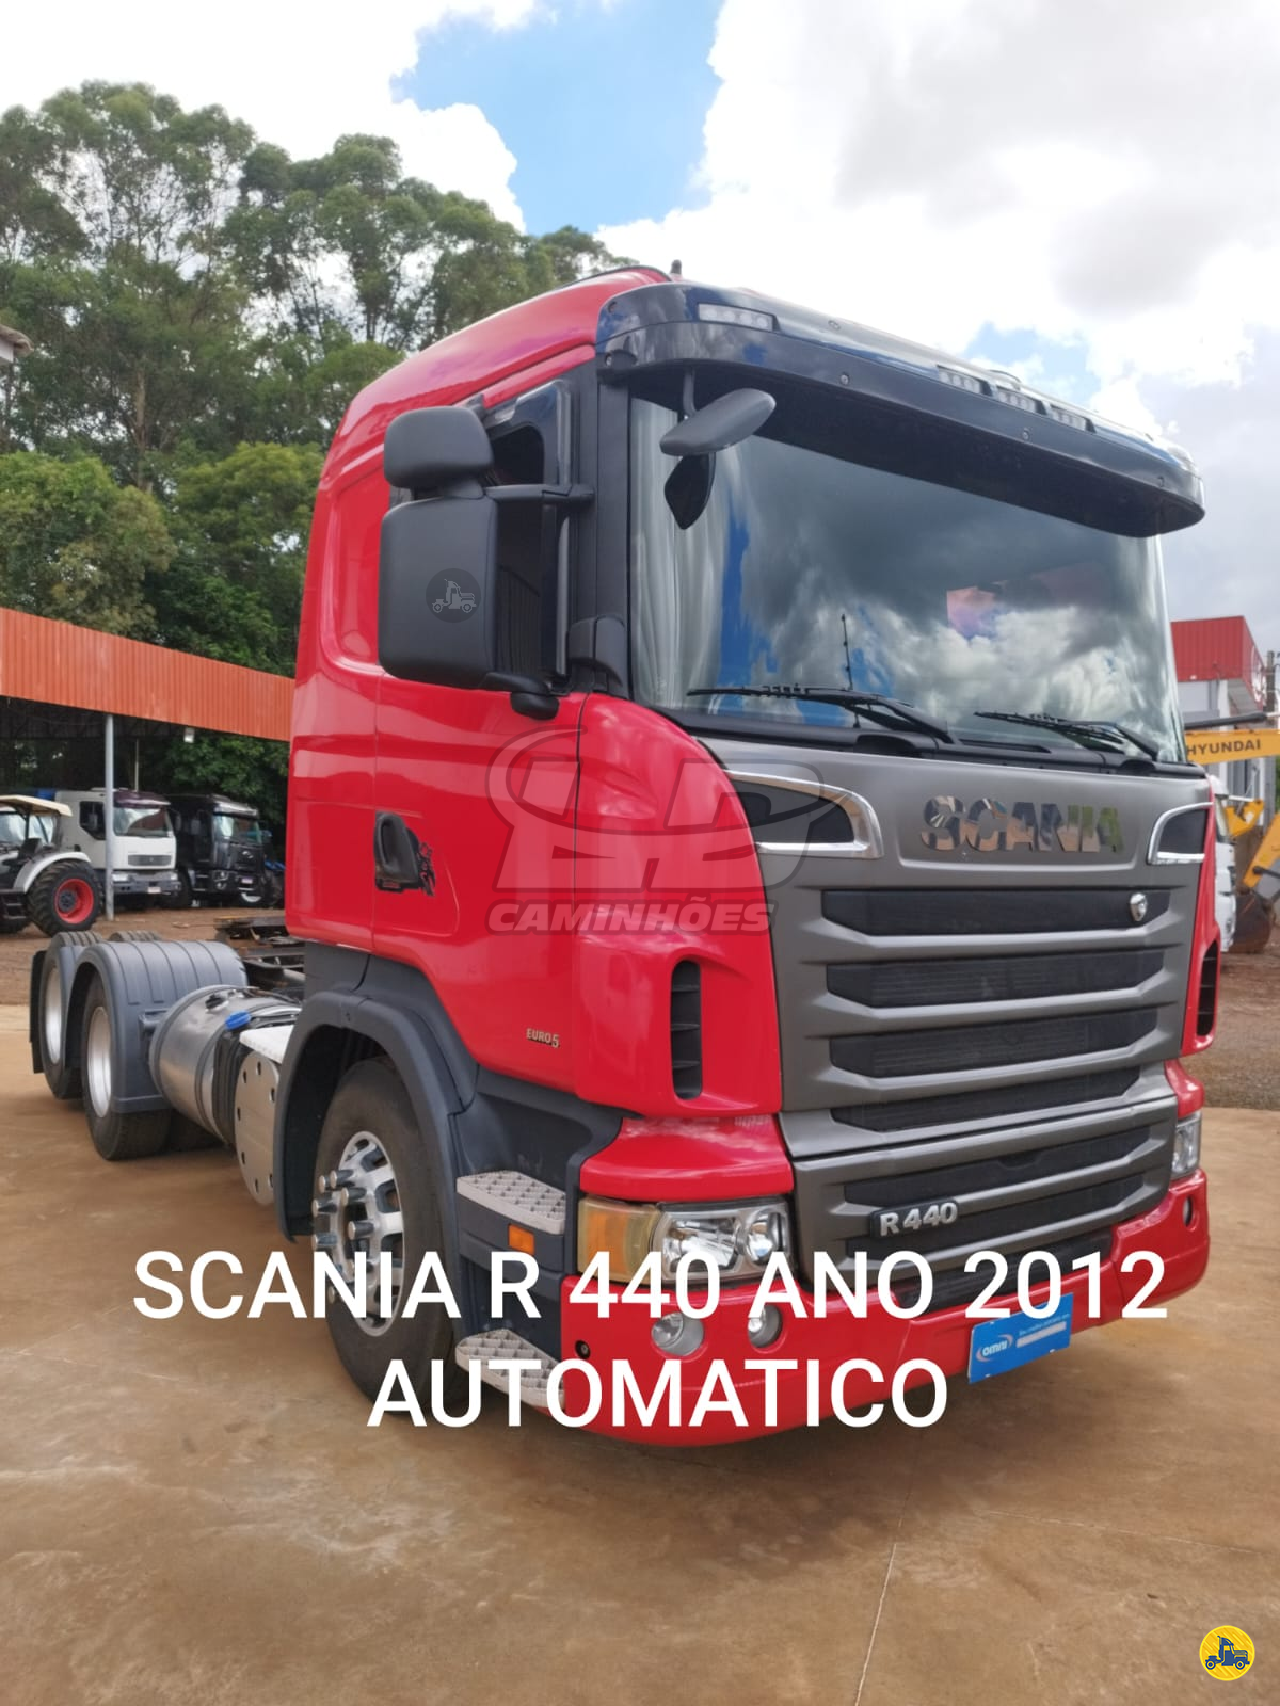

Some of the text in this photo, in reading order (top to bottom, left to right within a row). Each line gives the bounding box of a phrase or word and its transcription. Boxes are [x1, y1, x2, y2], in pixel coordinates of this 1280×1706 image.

[1187, 739, 1261, 755] HYUNDAI
[921, 795, 1123, 853] SCANIA
[526, 1028, 560, 1048] EURO 5
[880, 1202, 957, 1236] R 440
